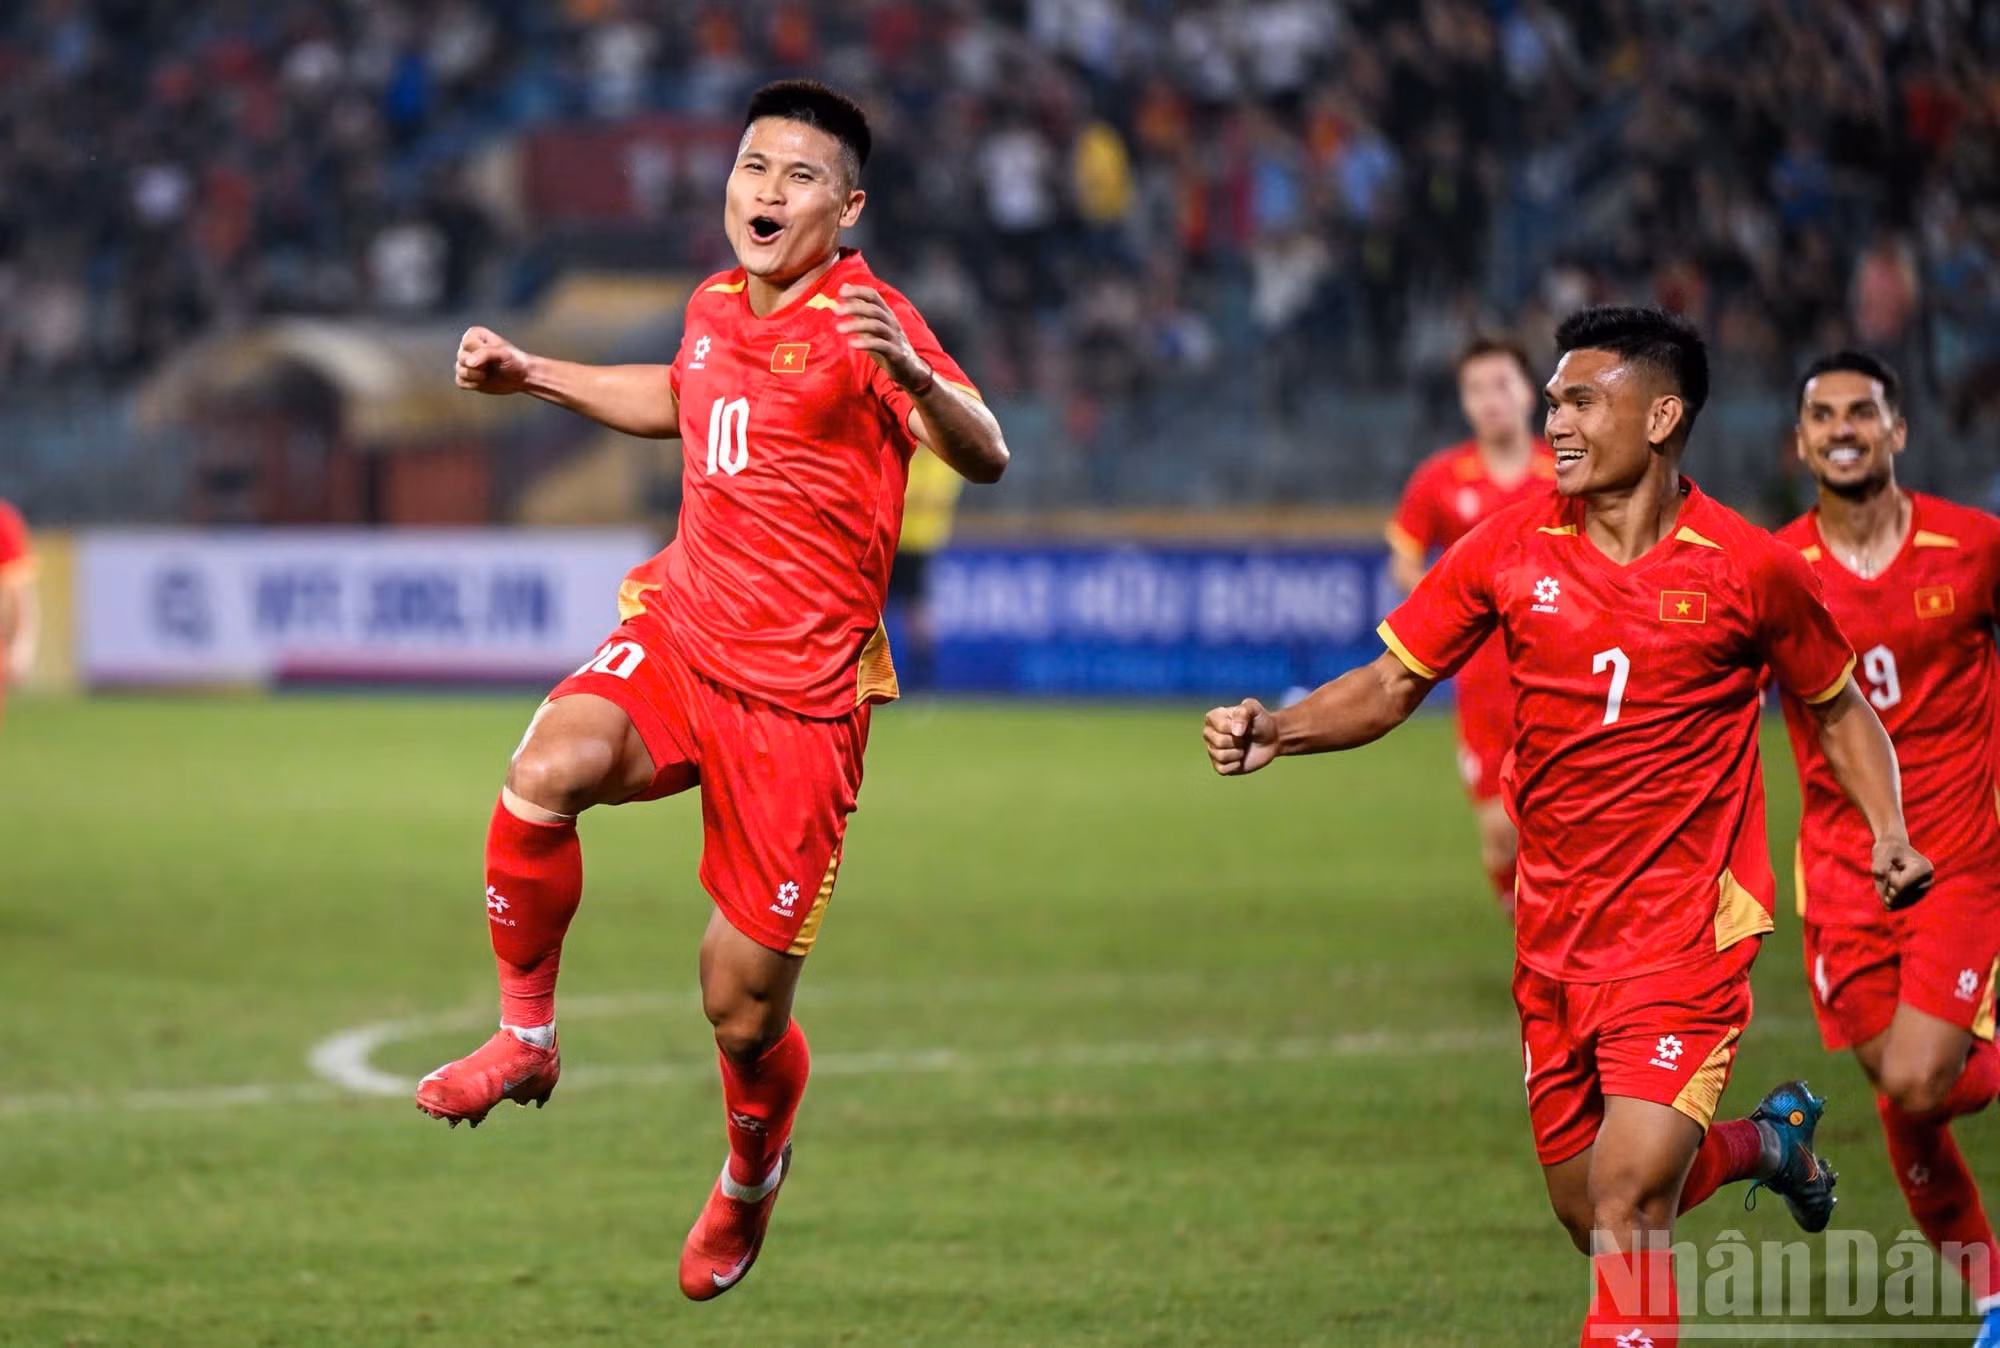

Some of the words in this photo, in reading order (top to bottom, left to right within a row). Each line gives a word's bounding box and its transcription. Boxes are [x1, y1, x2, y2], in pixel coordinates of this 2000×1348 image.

[706, 396, 750, 477] 10
[1592, 646, 1630, 725] 7
[1863, 644, 1902, 711] 9
